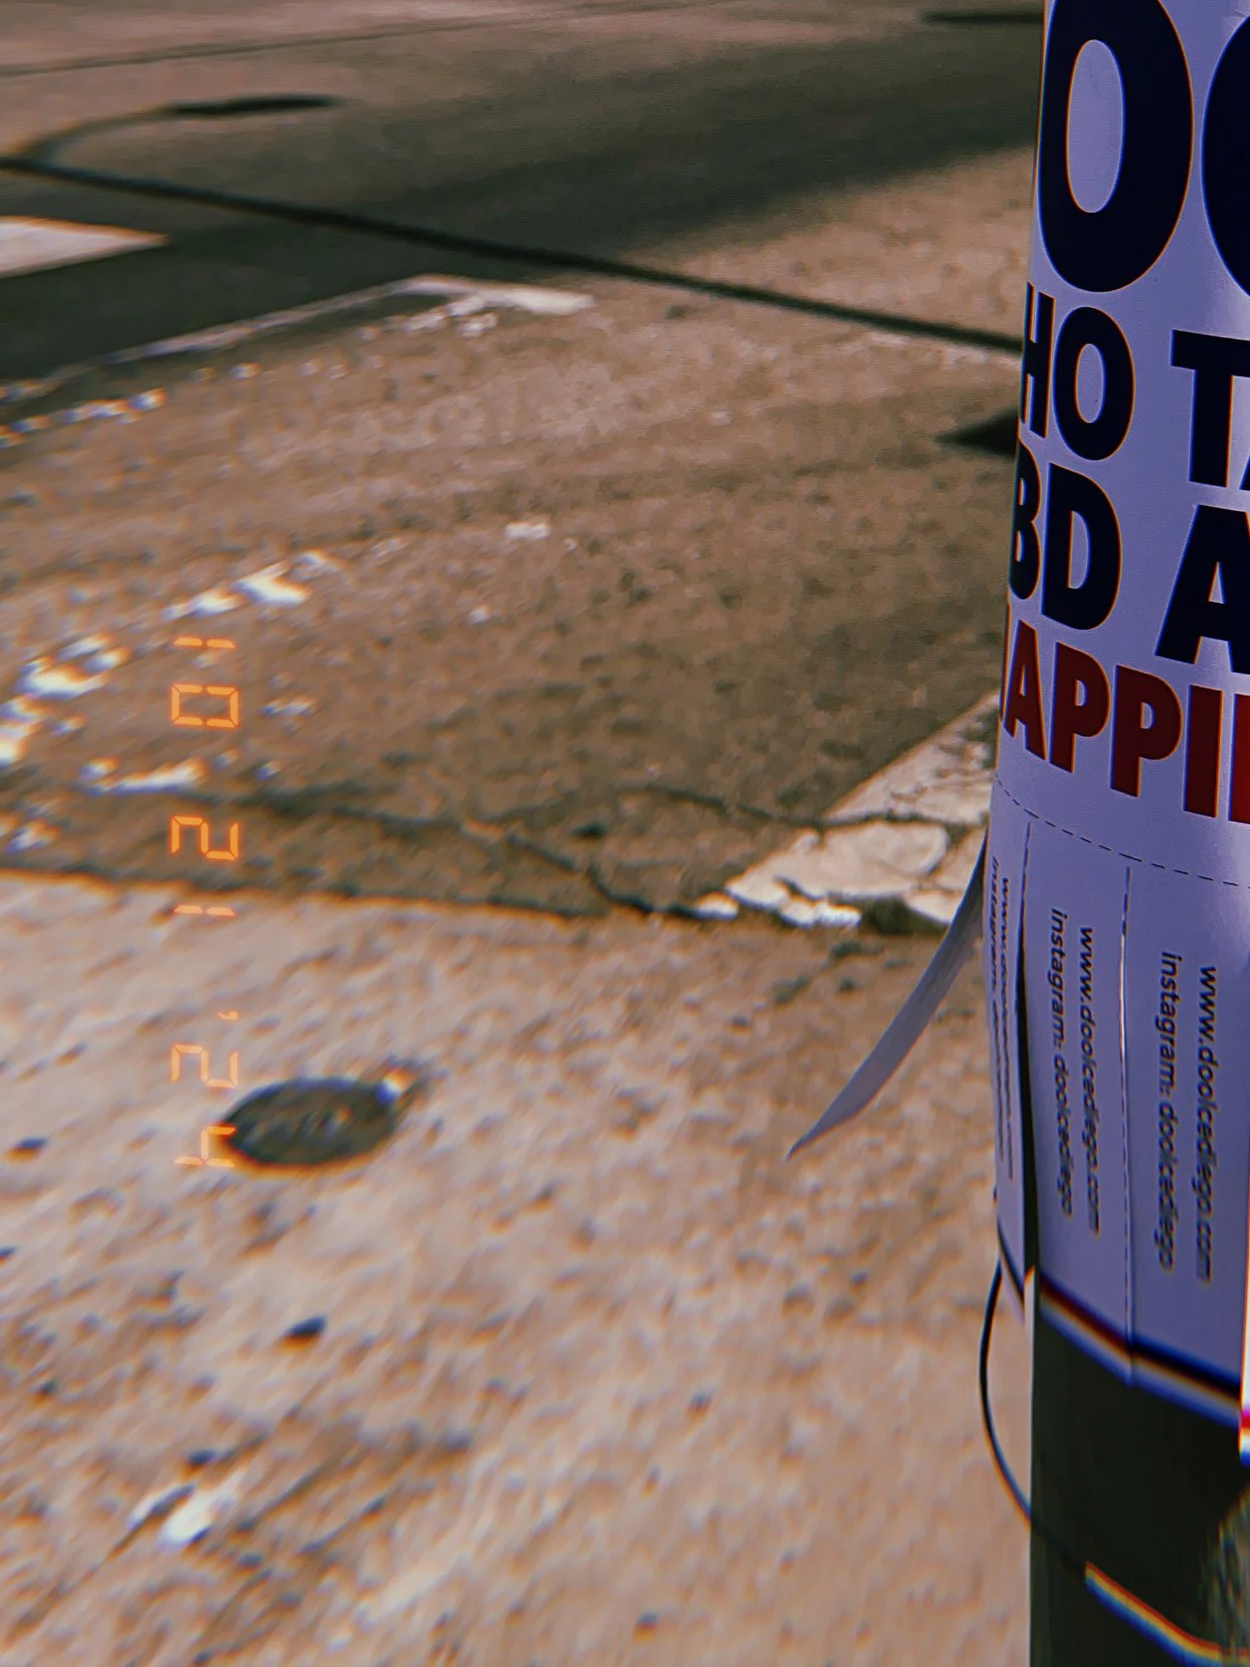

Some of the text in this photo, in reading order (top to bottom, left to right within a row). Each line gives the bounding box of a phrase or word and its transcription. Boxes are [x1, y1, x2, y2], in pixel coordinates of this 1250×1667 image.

[1047, 908, 1068, 1049] instagram:
[1154, 951, 1183, 1268] instagram: doolcediego
[1191, 966, 1219, 1282] www.doolcediego.com
